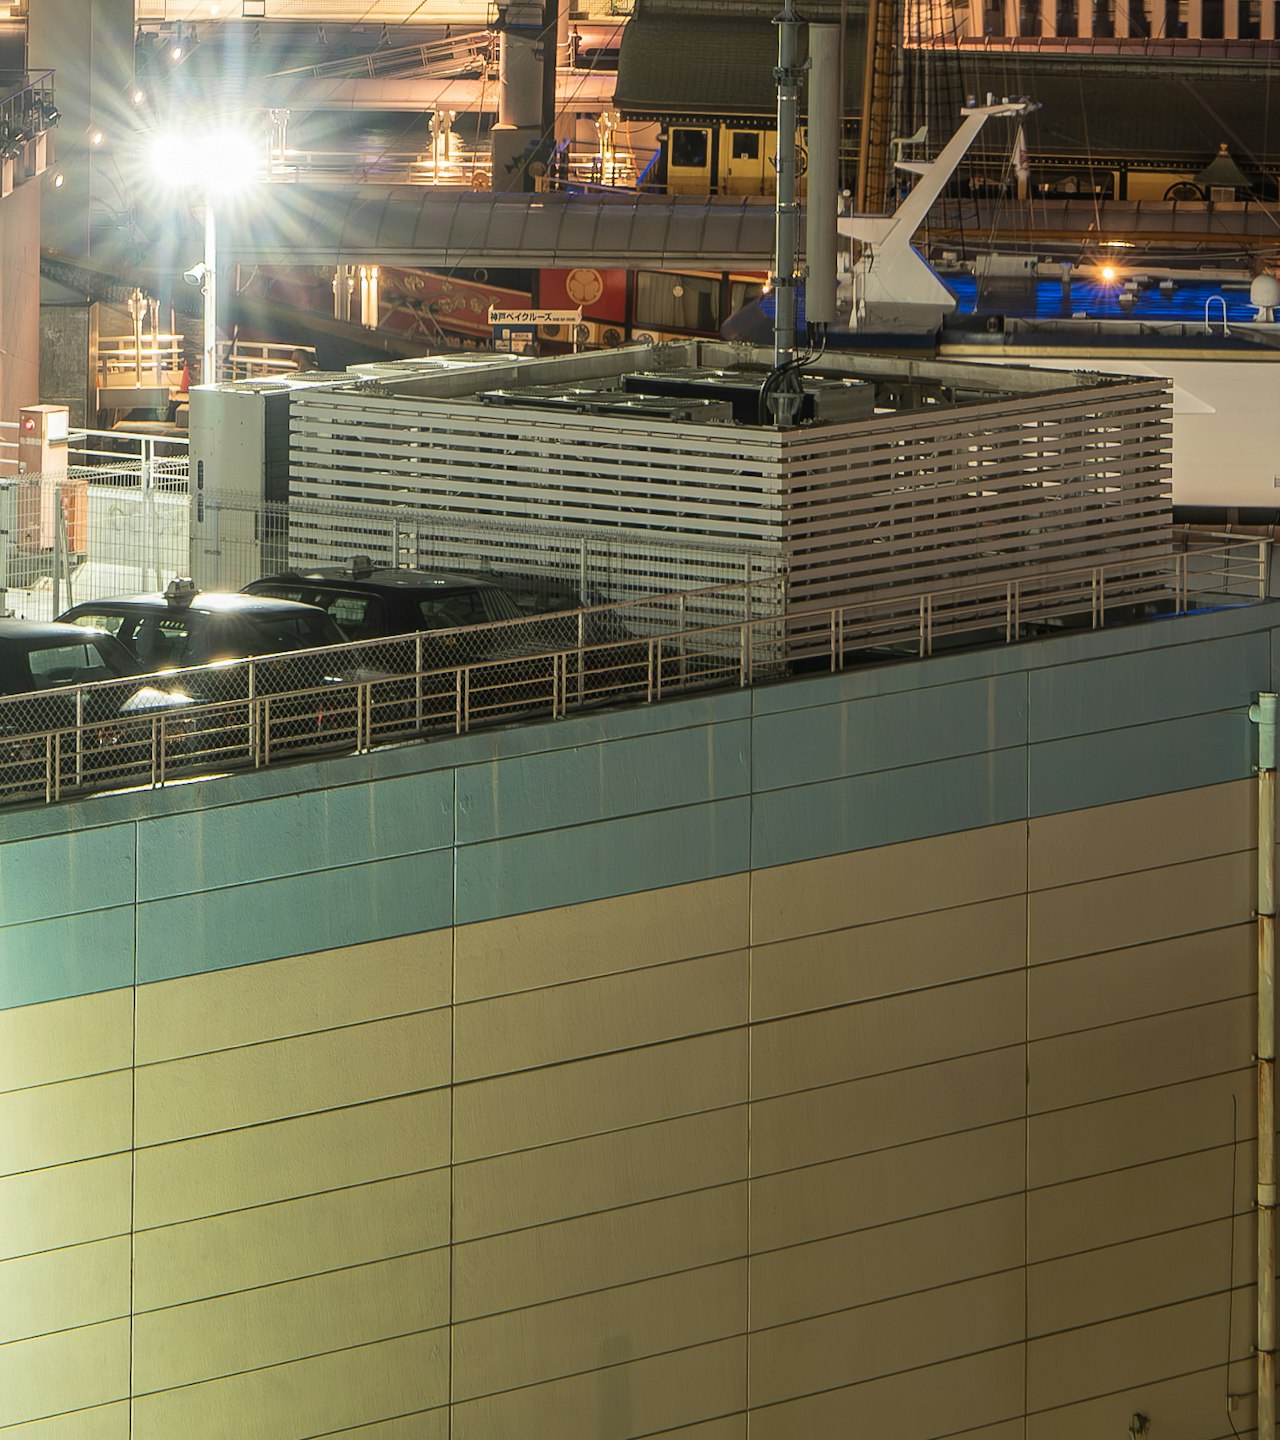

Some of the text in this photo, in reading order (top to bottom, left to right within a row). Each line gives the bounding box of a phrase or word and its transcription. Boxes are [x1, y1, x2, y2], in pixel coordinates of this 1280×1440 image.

[490, 311, 553, 322] 神戸ベイクルーズ
